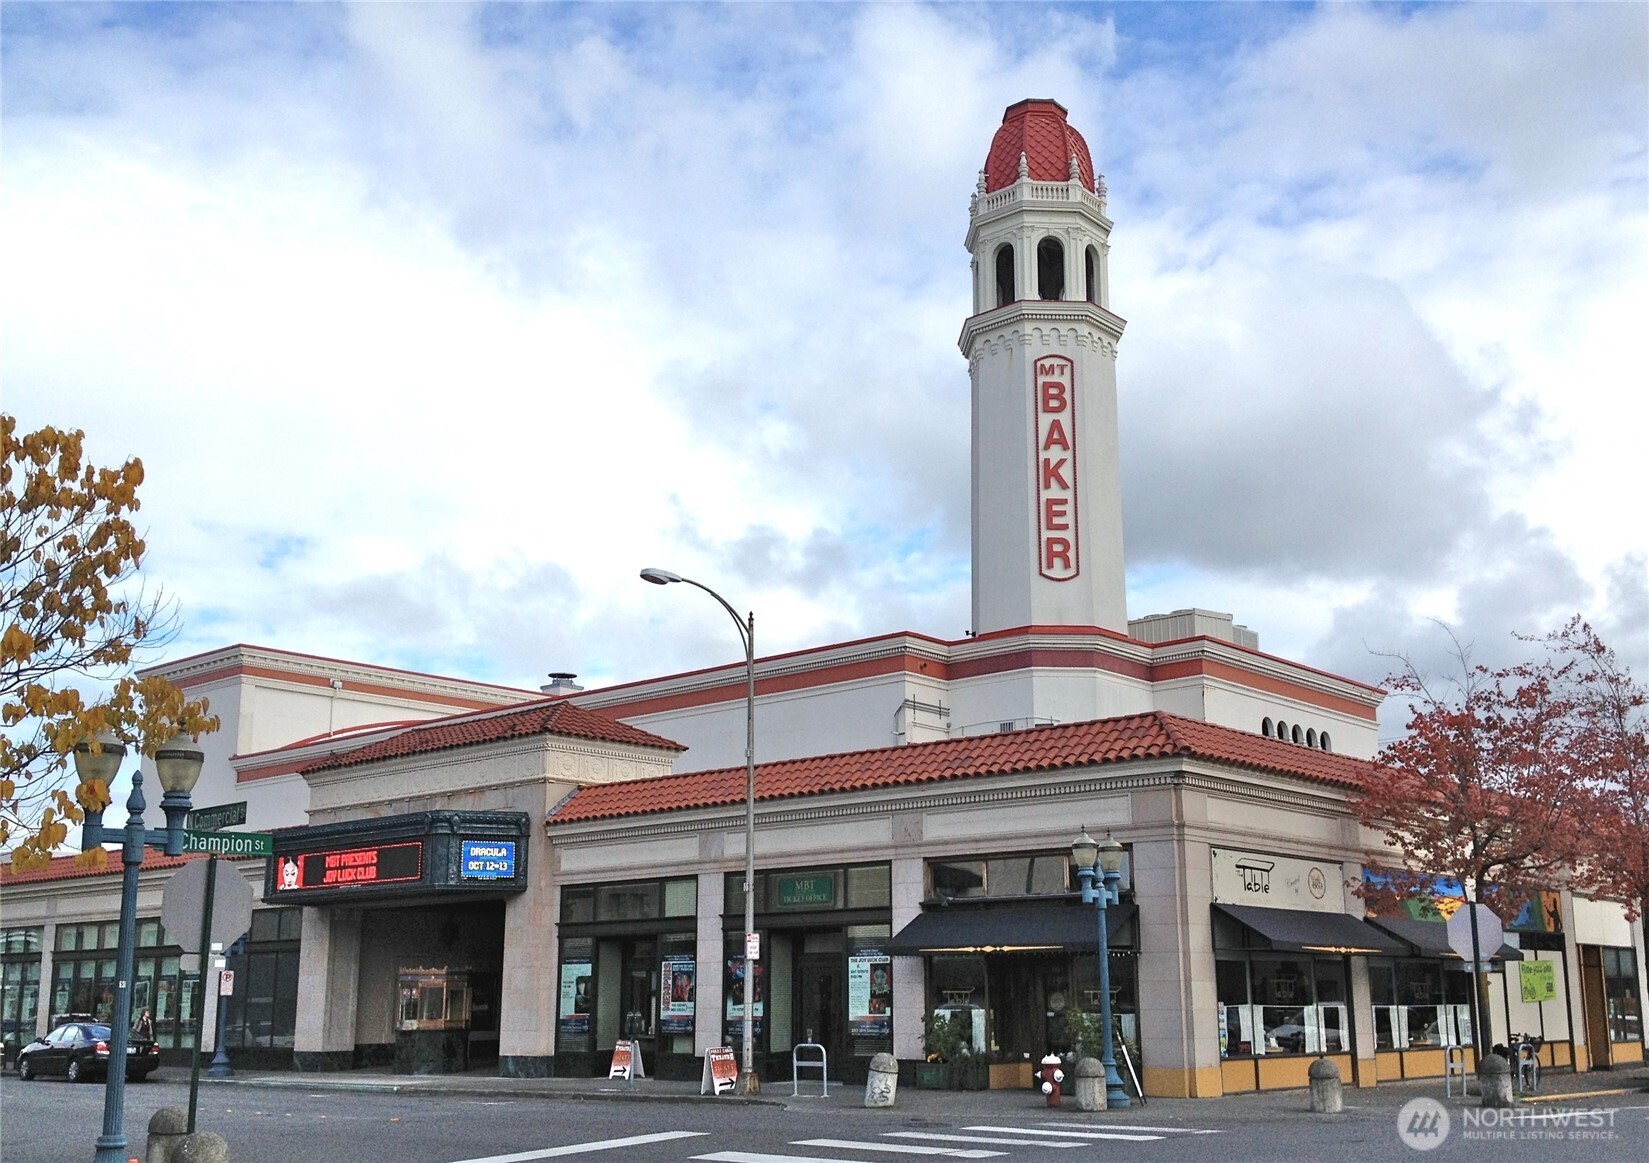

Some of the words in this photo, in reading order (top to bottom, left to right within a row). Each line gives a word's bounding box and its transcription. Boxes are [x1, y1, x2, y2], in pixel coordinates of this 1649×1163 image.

[1039, 362, 1068, 376] MT
[1041, 380, 1072, 570] BAKER
[187, 813, 194, 829] N
[194, 806, 239, 829] Commercial
[182, 832, 252, 854] Champion
[254, 840, 265, 851] St
[325, 855, 340, 868] MBT
[341, 851, 378, 866] PRESENTS
[470, 847, 507, 857] DRACULA
[323, 870, 337, 883] JOY
[338, 868, 356, 882] LUCK
[357, 866, 377, 880] CLUB
[468, 861, 485, 871] OCT
[795, 880, 816, 891] MBT
[1237, 862, 1272, 894] Table
